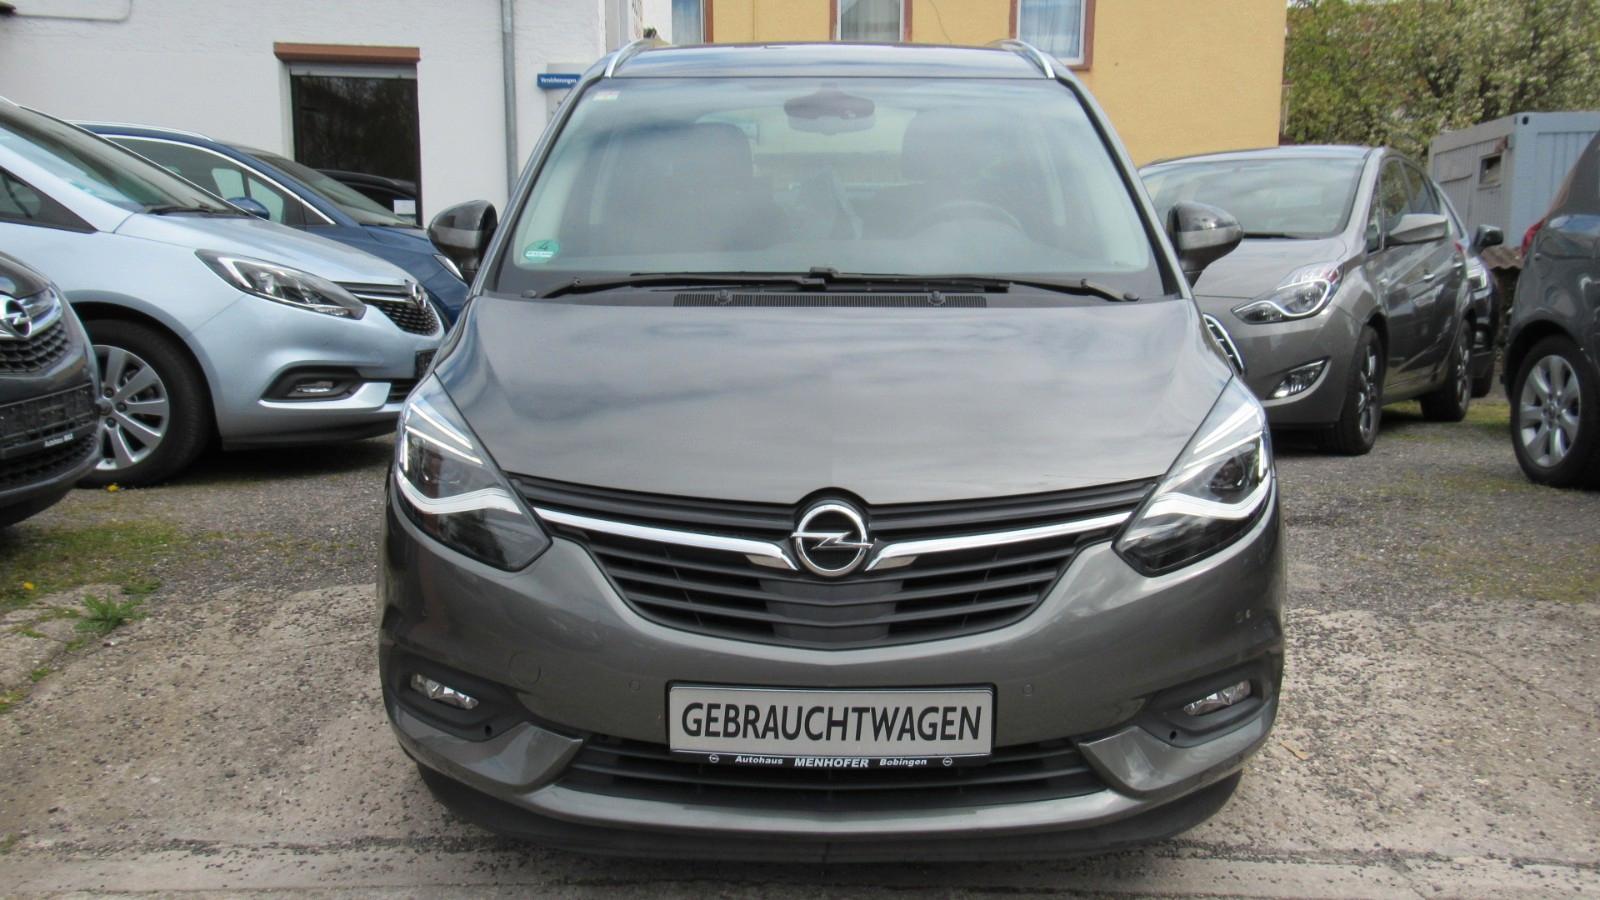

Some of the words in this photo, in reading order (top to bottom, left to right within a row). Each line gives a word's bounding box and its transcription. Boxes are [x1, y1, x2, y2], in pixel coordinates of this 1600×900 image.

[682, 702, 982, 742] GEBRAUCHTWAGEN
[735, 755, 784, 765] Autohaus
[794, 757, 869, 768] MENHOFER
[879, 758, 928, 767] Bobingen
